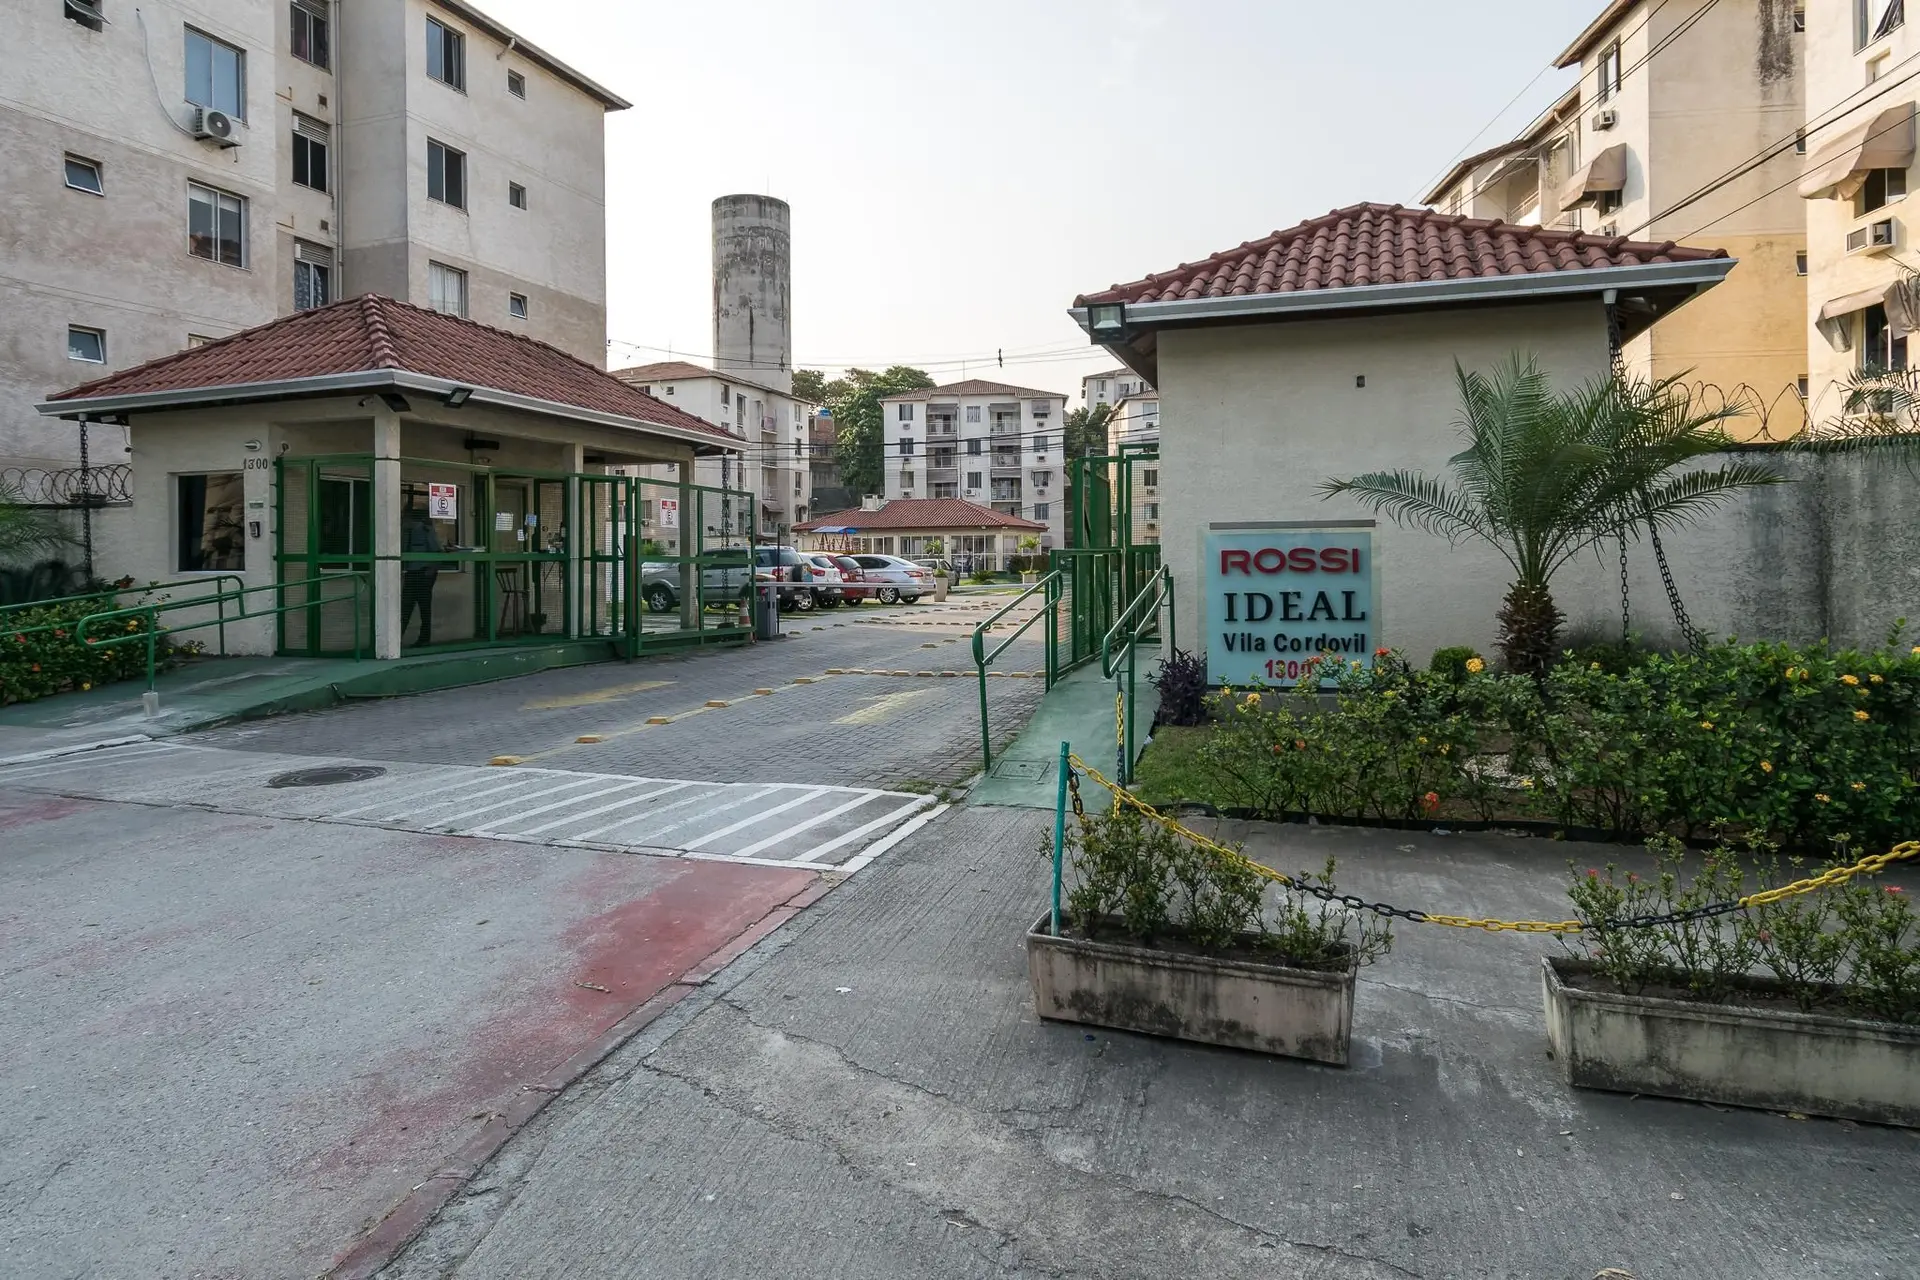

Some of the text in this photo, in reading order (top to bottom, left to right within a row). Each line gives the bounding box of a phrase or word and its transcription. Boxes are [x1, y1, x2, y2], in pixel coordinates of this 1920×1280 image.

[244, 458, 268, 470] 1300
[1220, 548, 1360, 576] ROSSI
[1224, 590, 1366, 622] IDEAL
[1222, 632, 1366, 653] Vila Cordovil
